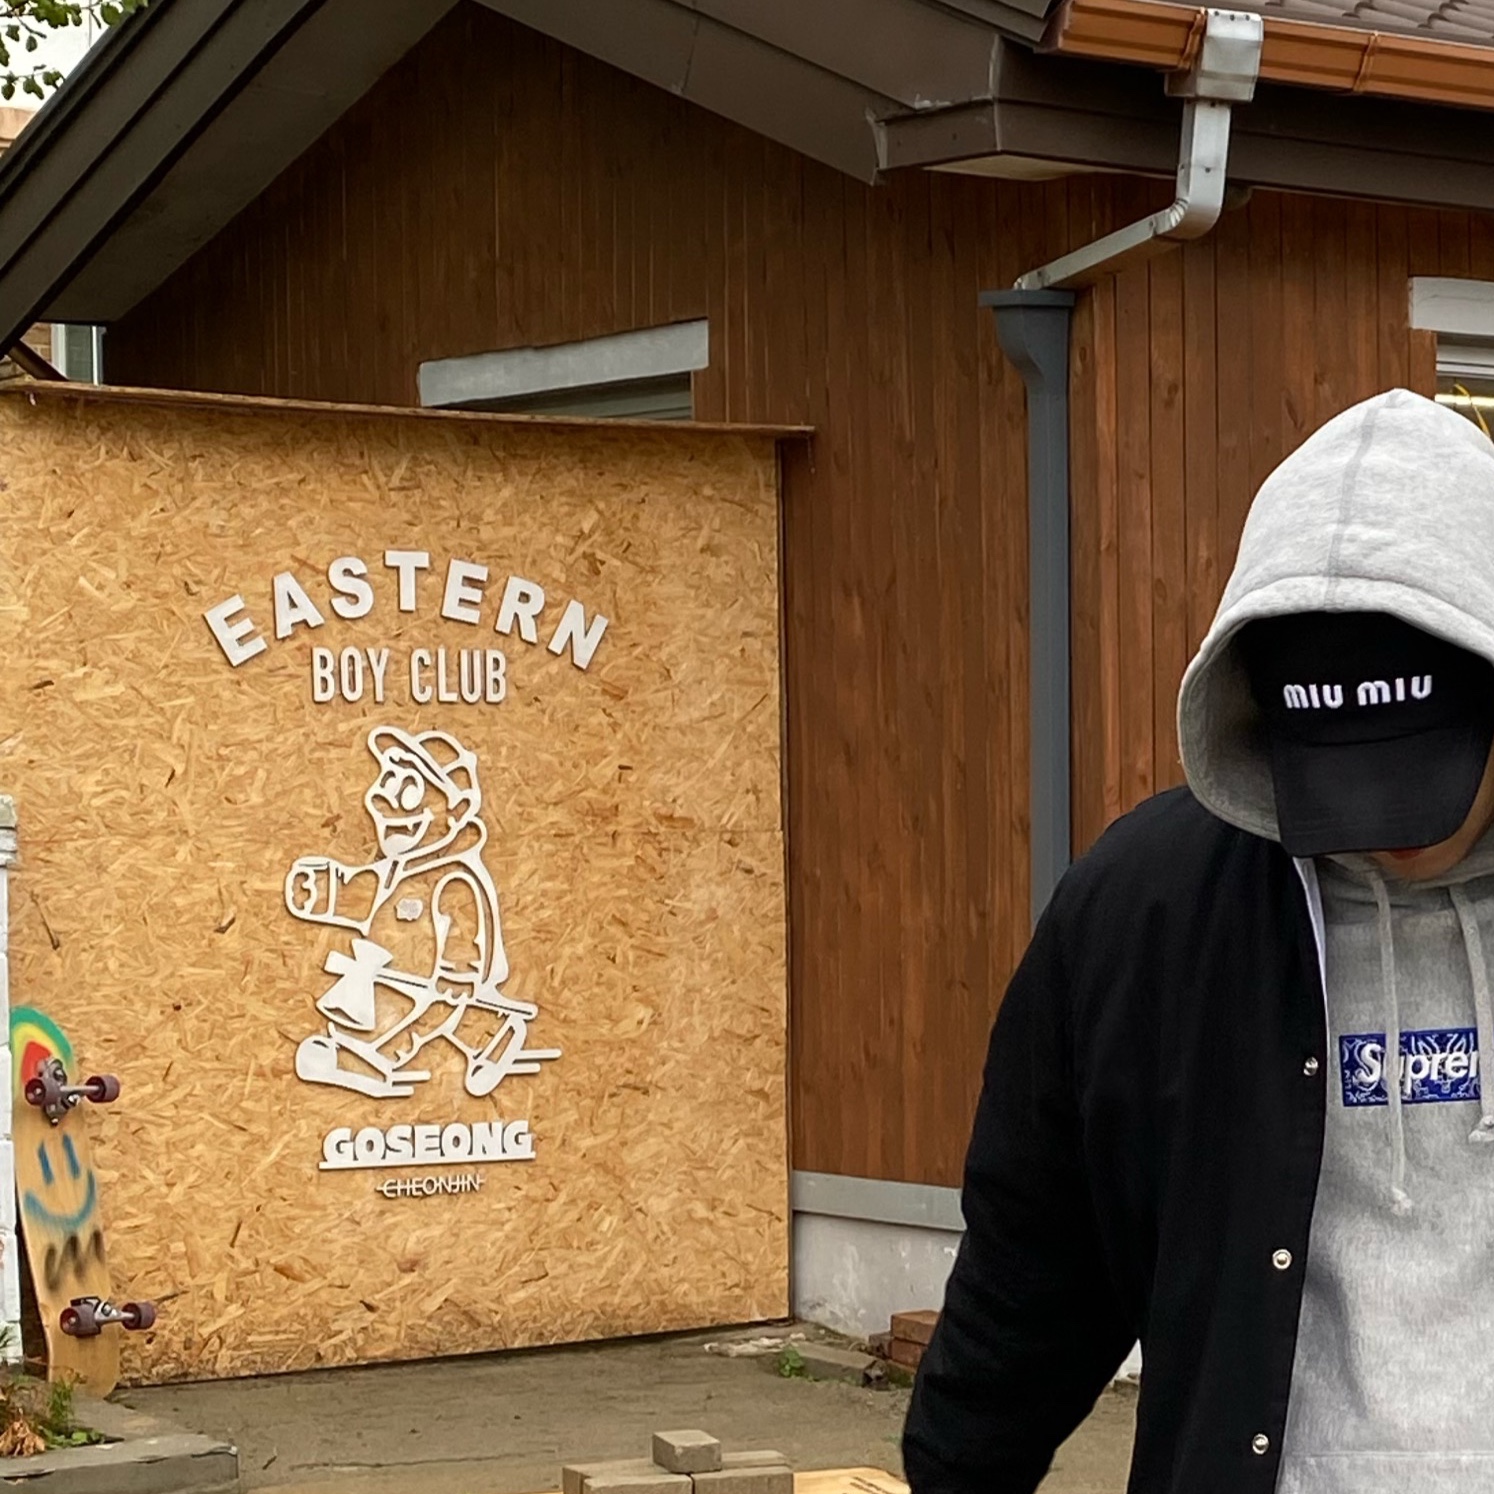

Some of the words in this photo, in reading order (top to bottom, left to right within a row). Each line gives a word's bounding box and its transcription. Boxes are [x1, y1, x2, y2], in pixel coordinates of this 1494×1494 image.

[203, 549, 610, 671] EASTERN
[312, 645, 390, 703] BOY
[410, 646, 508, 704] CLUB
[321, 1119, 535, 1167] GOSEONG
